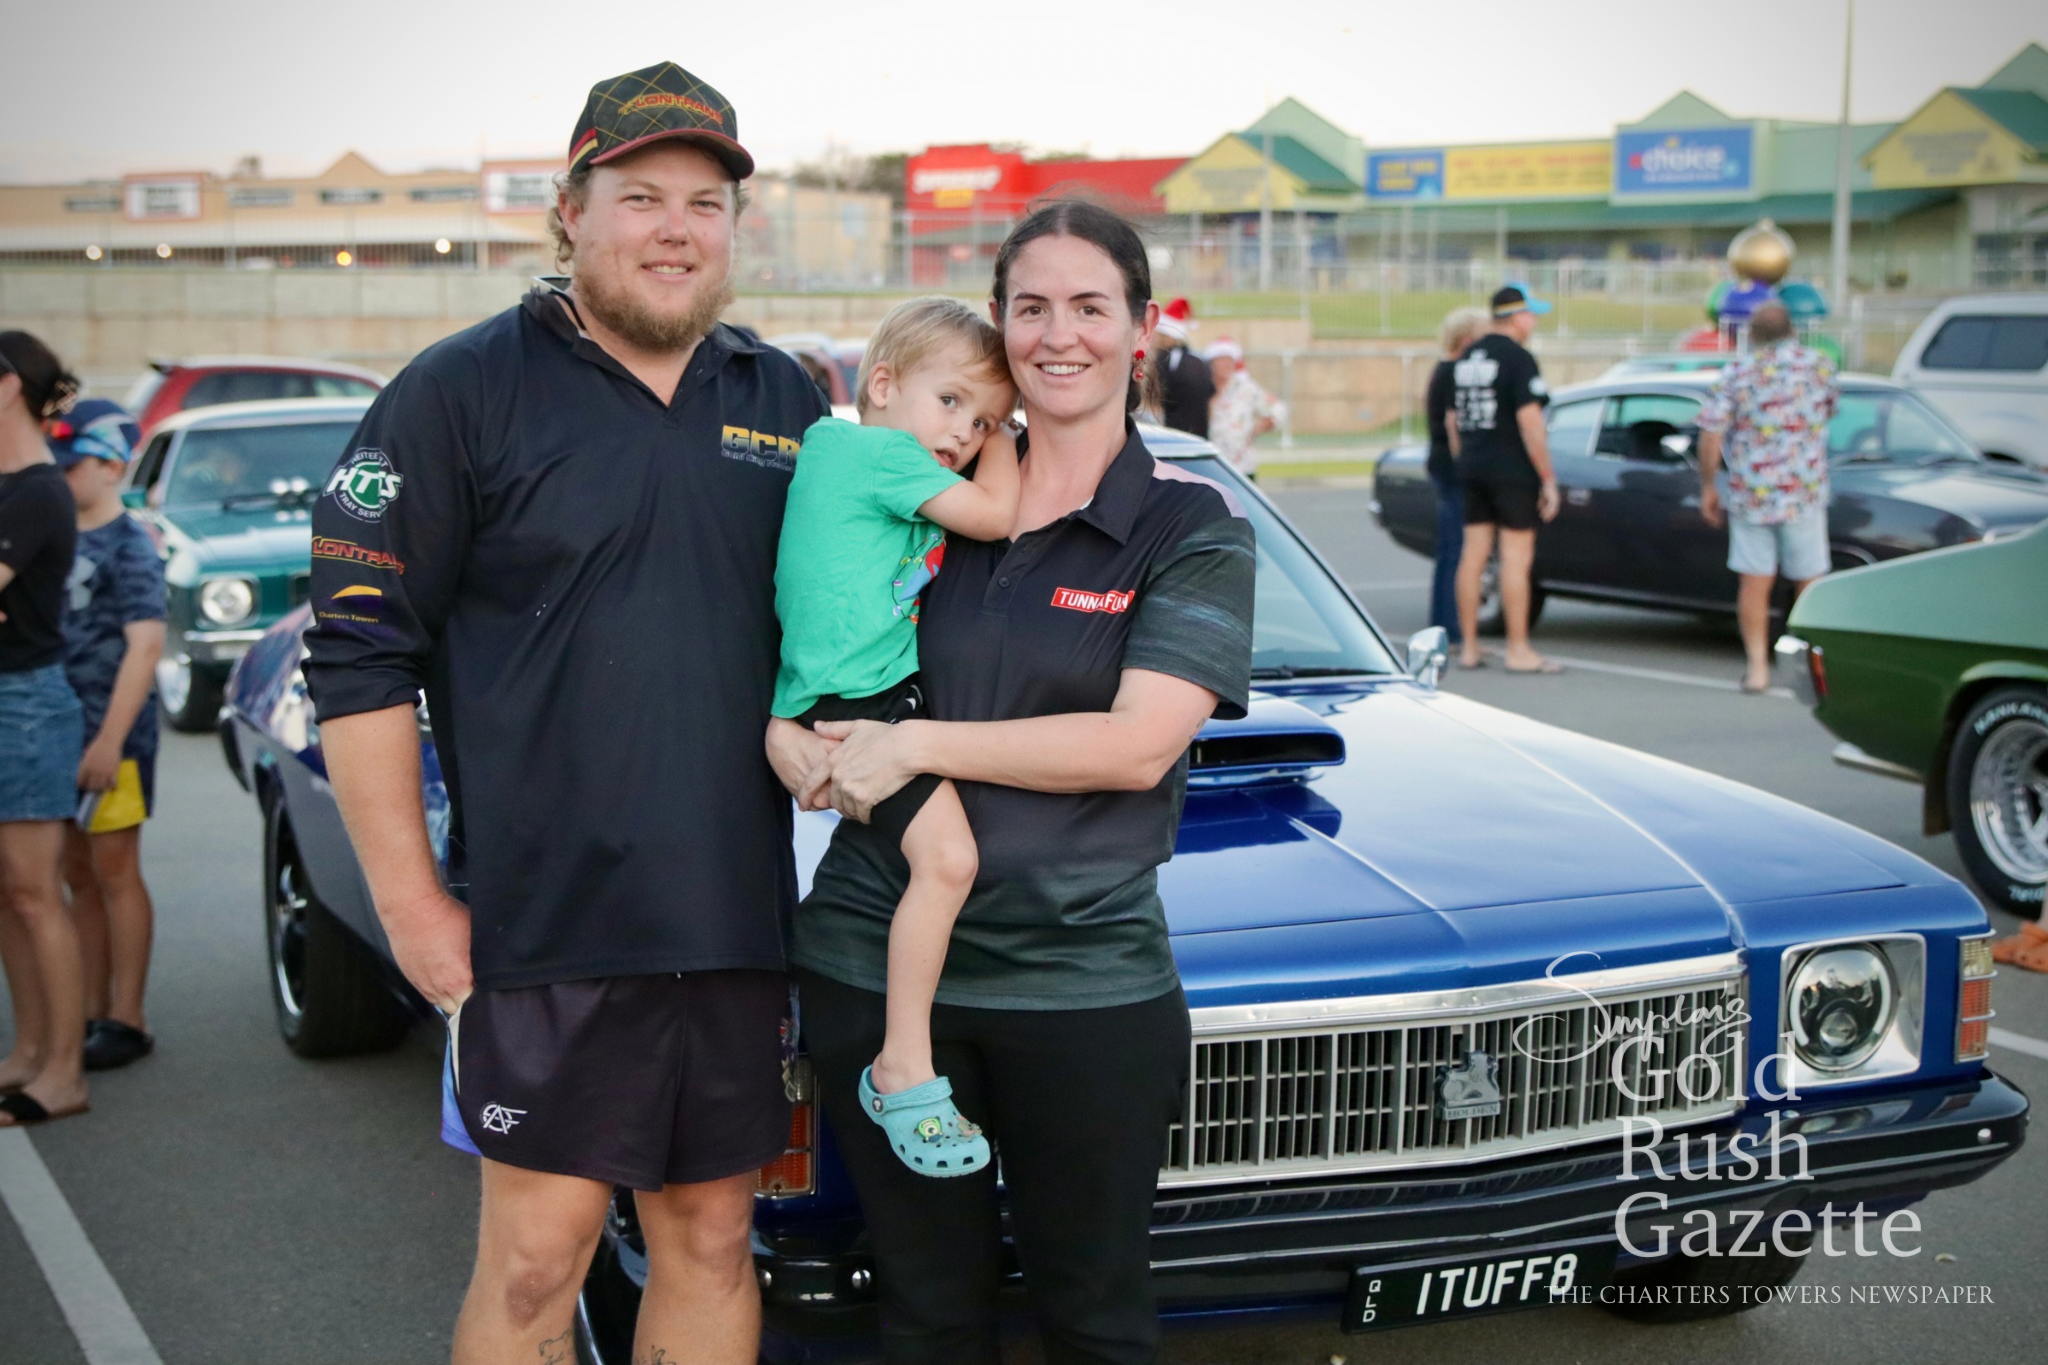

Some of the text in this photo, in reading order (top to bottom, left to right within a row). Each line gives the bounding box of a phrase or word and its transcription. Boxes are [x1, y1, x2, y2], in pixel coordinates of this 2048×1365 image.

[339, 491, 358, 511] TRAY
[351, 614, 380, 623] Towers
[1446, 1104, 1498, 1118] HOLDEN
[1361, 1279, 1382, 1323] QLD
